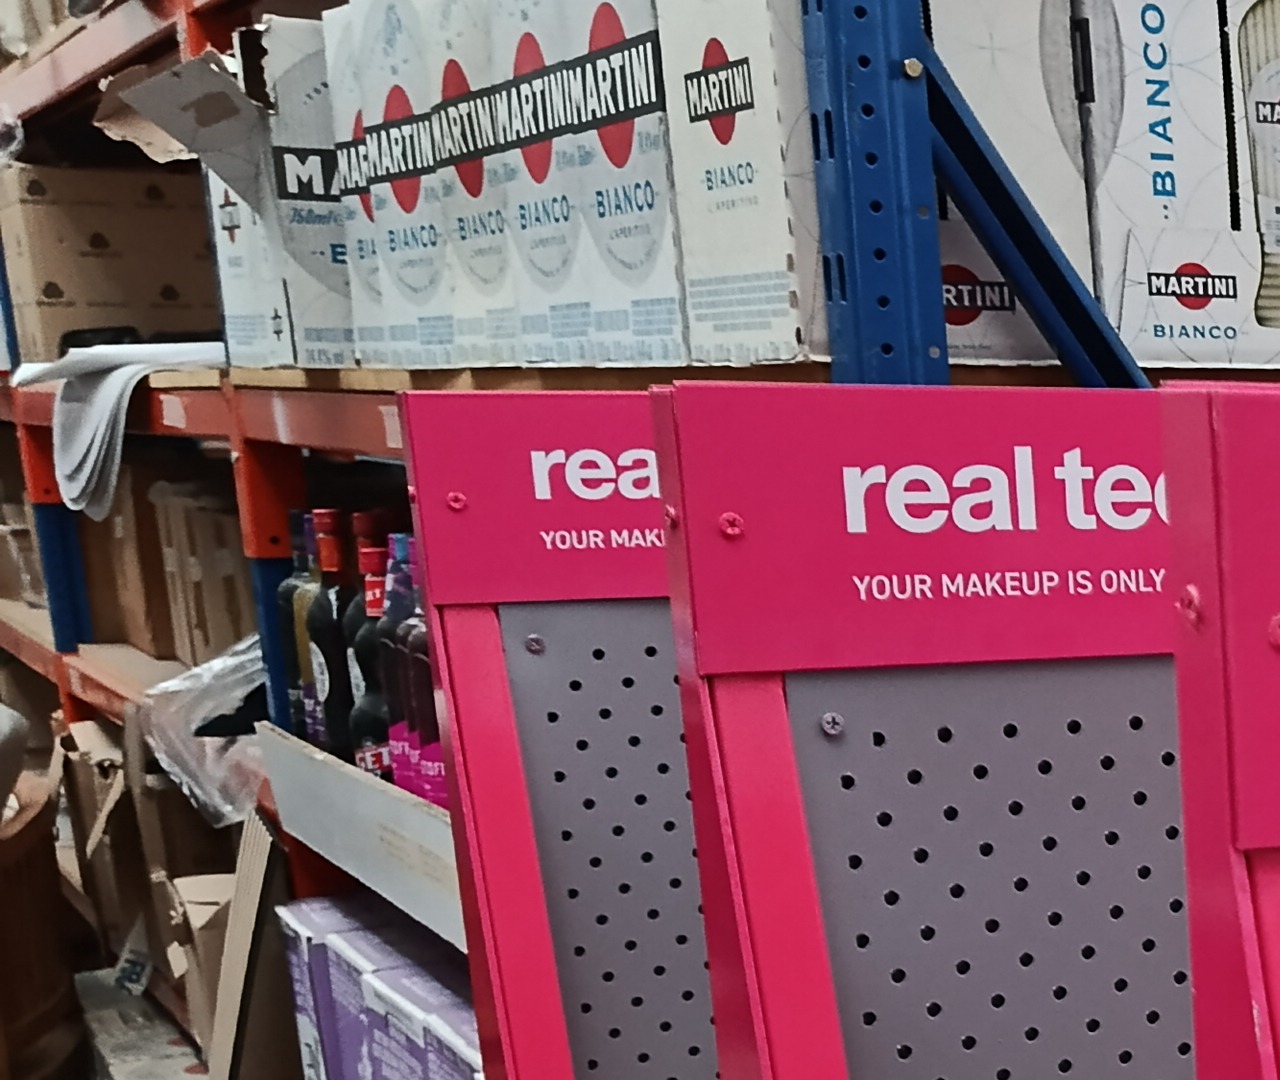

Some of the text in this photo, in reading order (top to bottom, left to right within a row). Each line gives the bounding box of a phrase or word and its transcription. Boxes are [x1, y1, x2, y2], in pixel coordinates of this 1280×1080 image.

[569, 42, 657, 124] MARTINI
[687, 64, 752, 116] MARTINI
[1141, 3, 1177, 198] BIANCO
[705, 162, 754, 190] BIANCO
[519, 195, 570, 230] BIANCO
[595, 180, 655, 218] BIANCO
[388, 224, 438, 252] BIANCO
[1151, 276, 1235, 297] MARTINI
[1153, 324, 1238, 340] BIANCO
[843, 446, 1038, 533] real
[540, 530, 605, 549] YOUR
[853, 569, 1166, 600] YOUR MAKEUP IS ONLY
